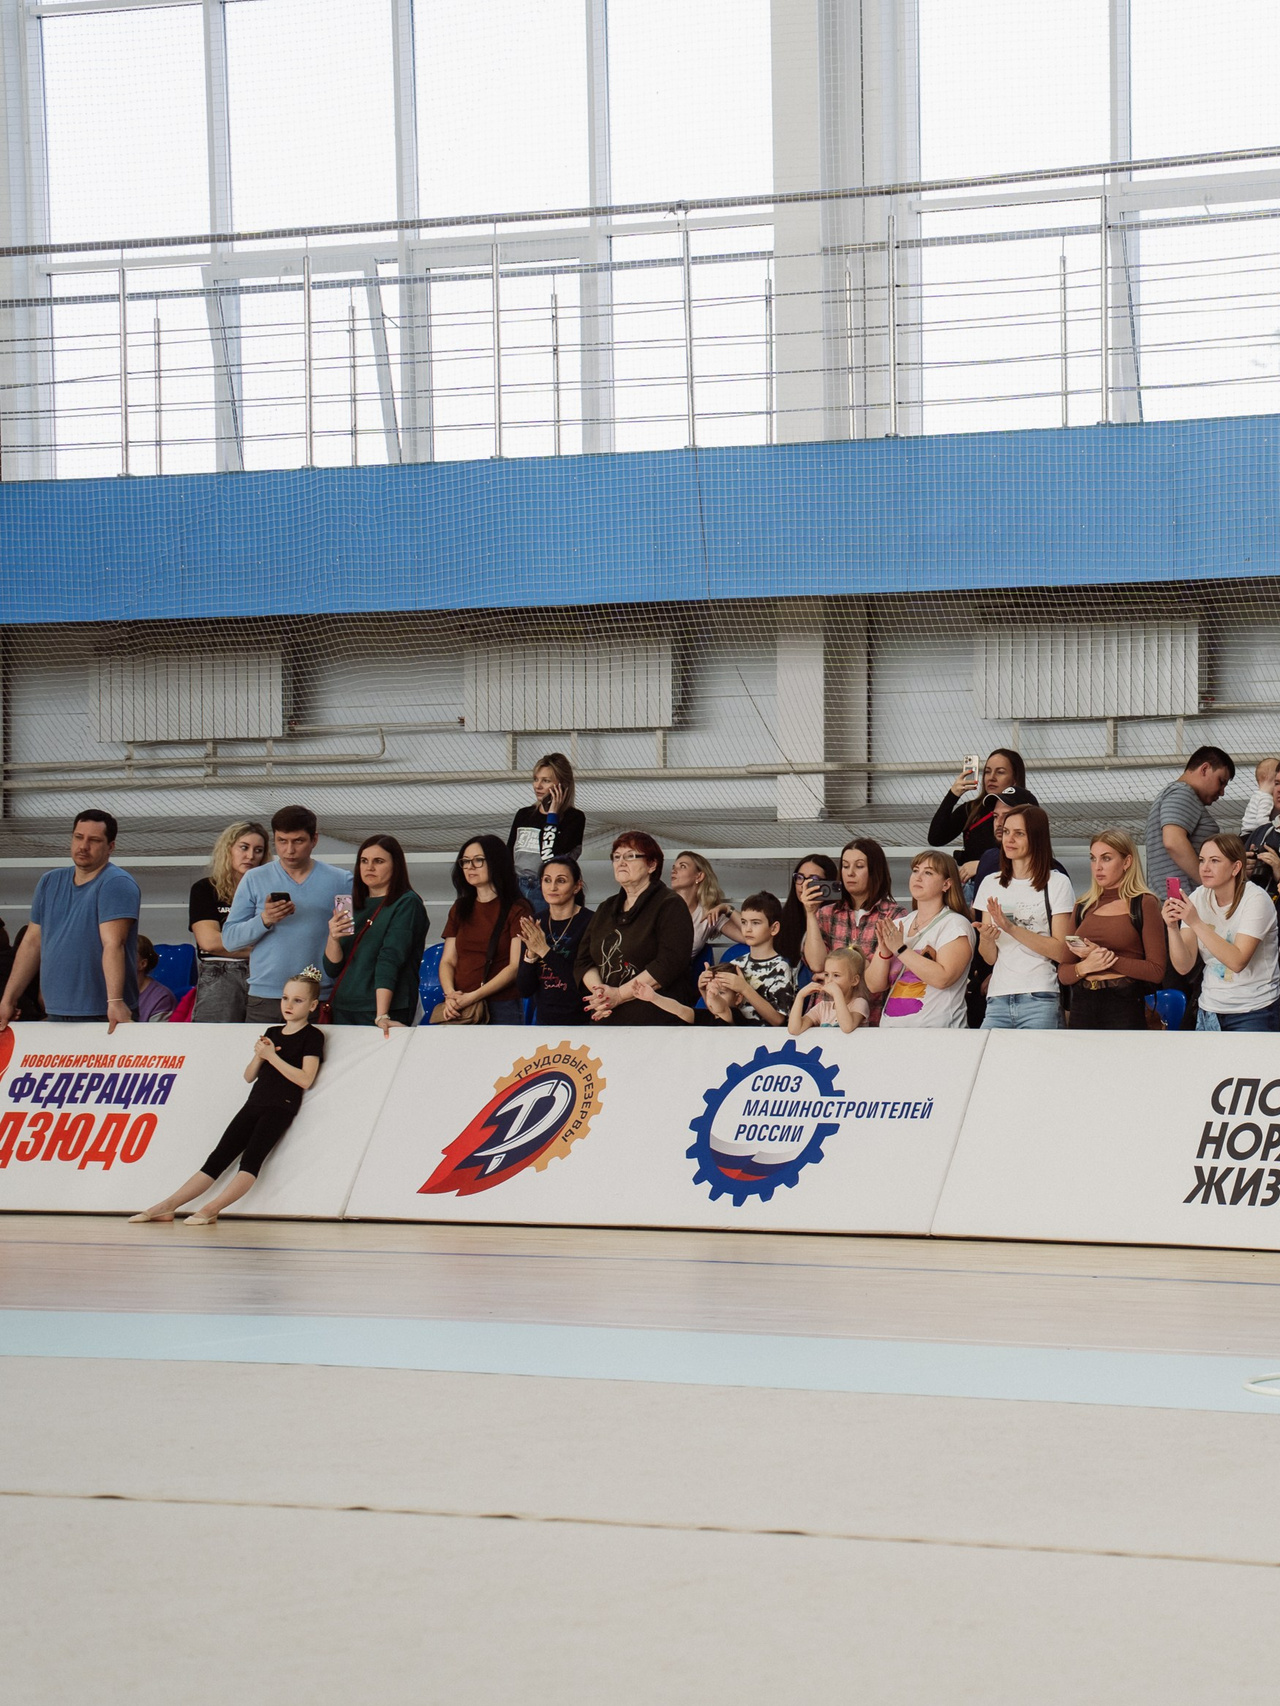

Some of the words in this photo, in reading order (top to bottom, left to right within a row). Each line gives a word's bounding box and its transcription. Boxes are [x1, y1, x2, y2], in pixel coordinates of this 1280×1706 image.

[541, 825, 557, 863] NESS
[20, 1054, 117, 1068] НОВОСИБИРСКАЯ
[116, 1055, 186, 1069] ОБЛАСТНАЯ
[8, 1072, 178, 1110] ФЕДЕРАЦИЯ
[515, 1054, 588, 1080] ТРУДОВЫЕ
[561, 1073, 594, 1142] РЕЗЕРВЫ
[751, 1075, 803, 1093] СОЮЗ
[742, 1098, 934, 1119] МАШИНОСТРОИТЕЛЕЙ
[0, 1111, 158, 1171] ДЗЮДО
[734, 1124, 804, 1142] РОССИИ
